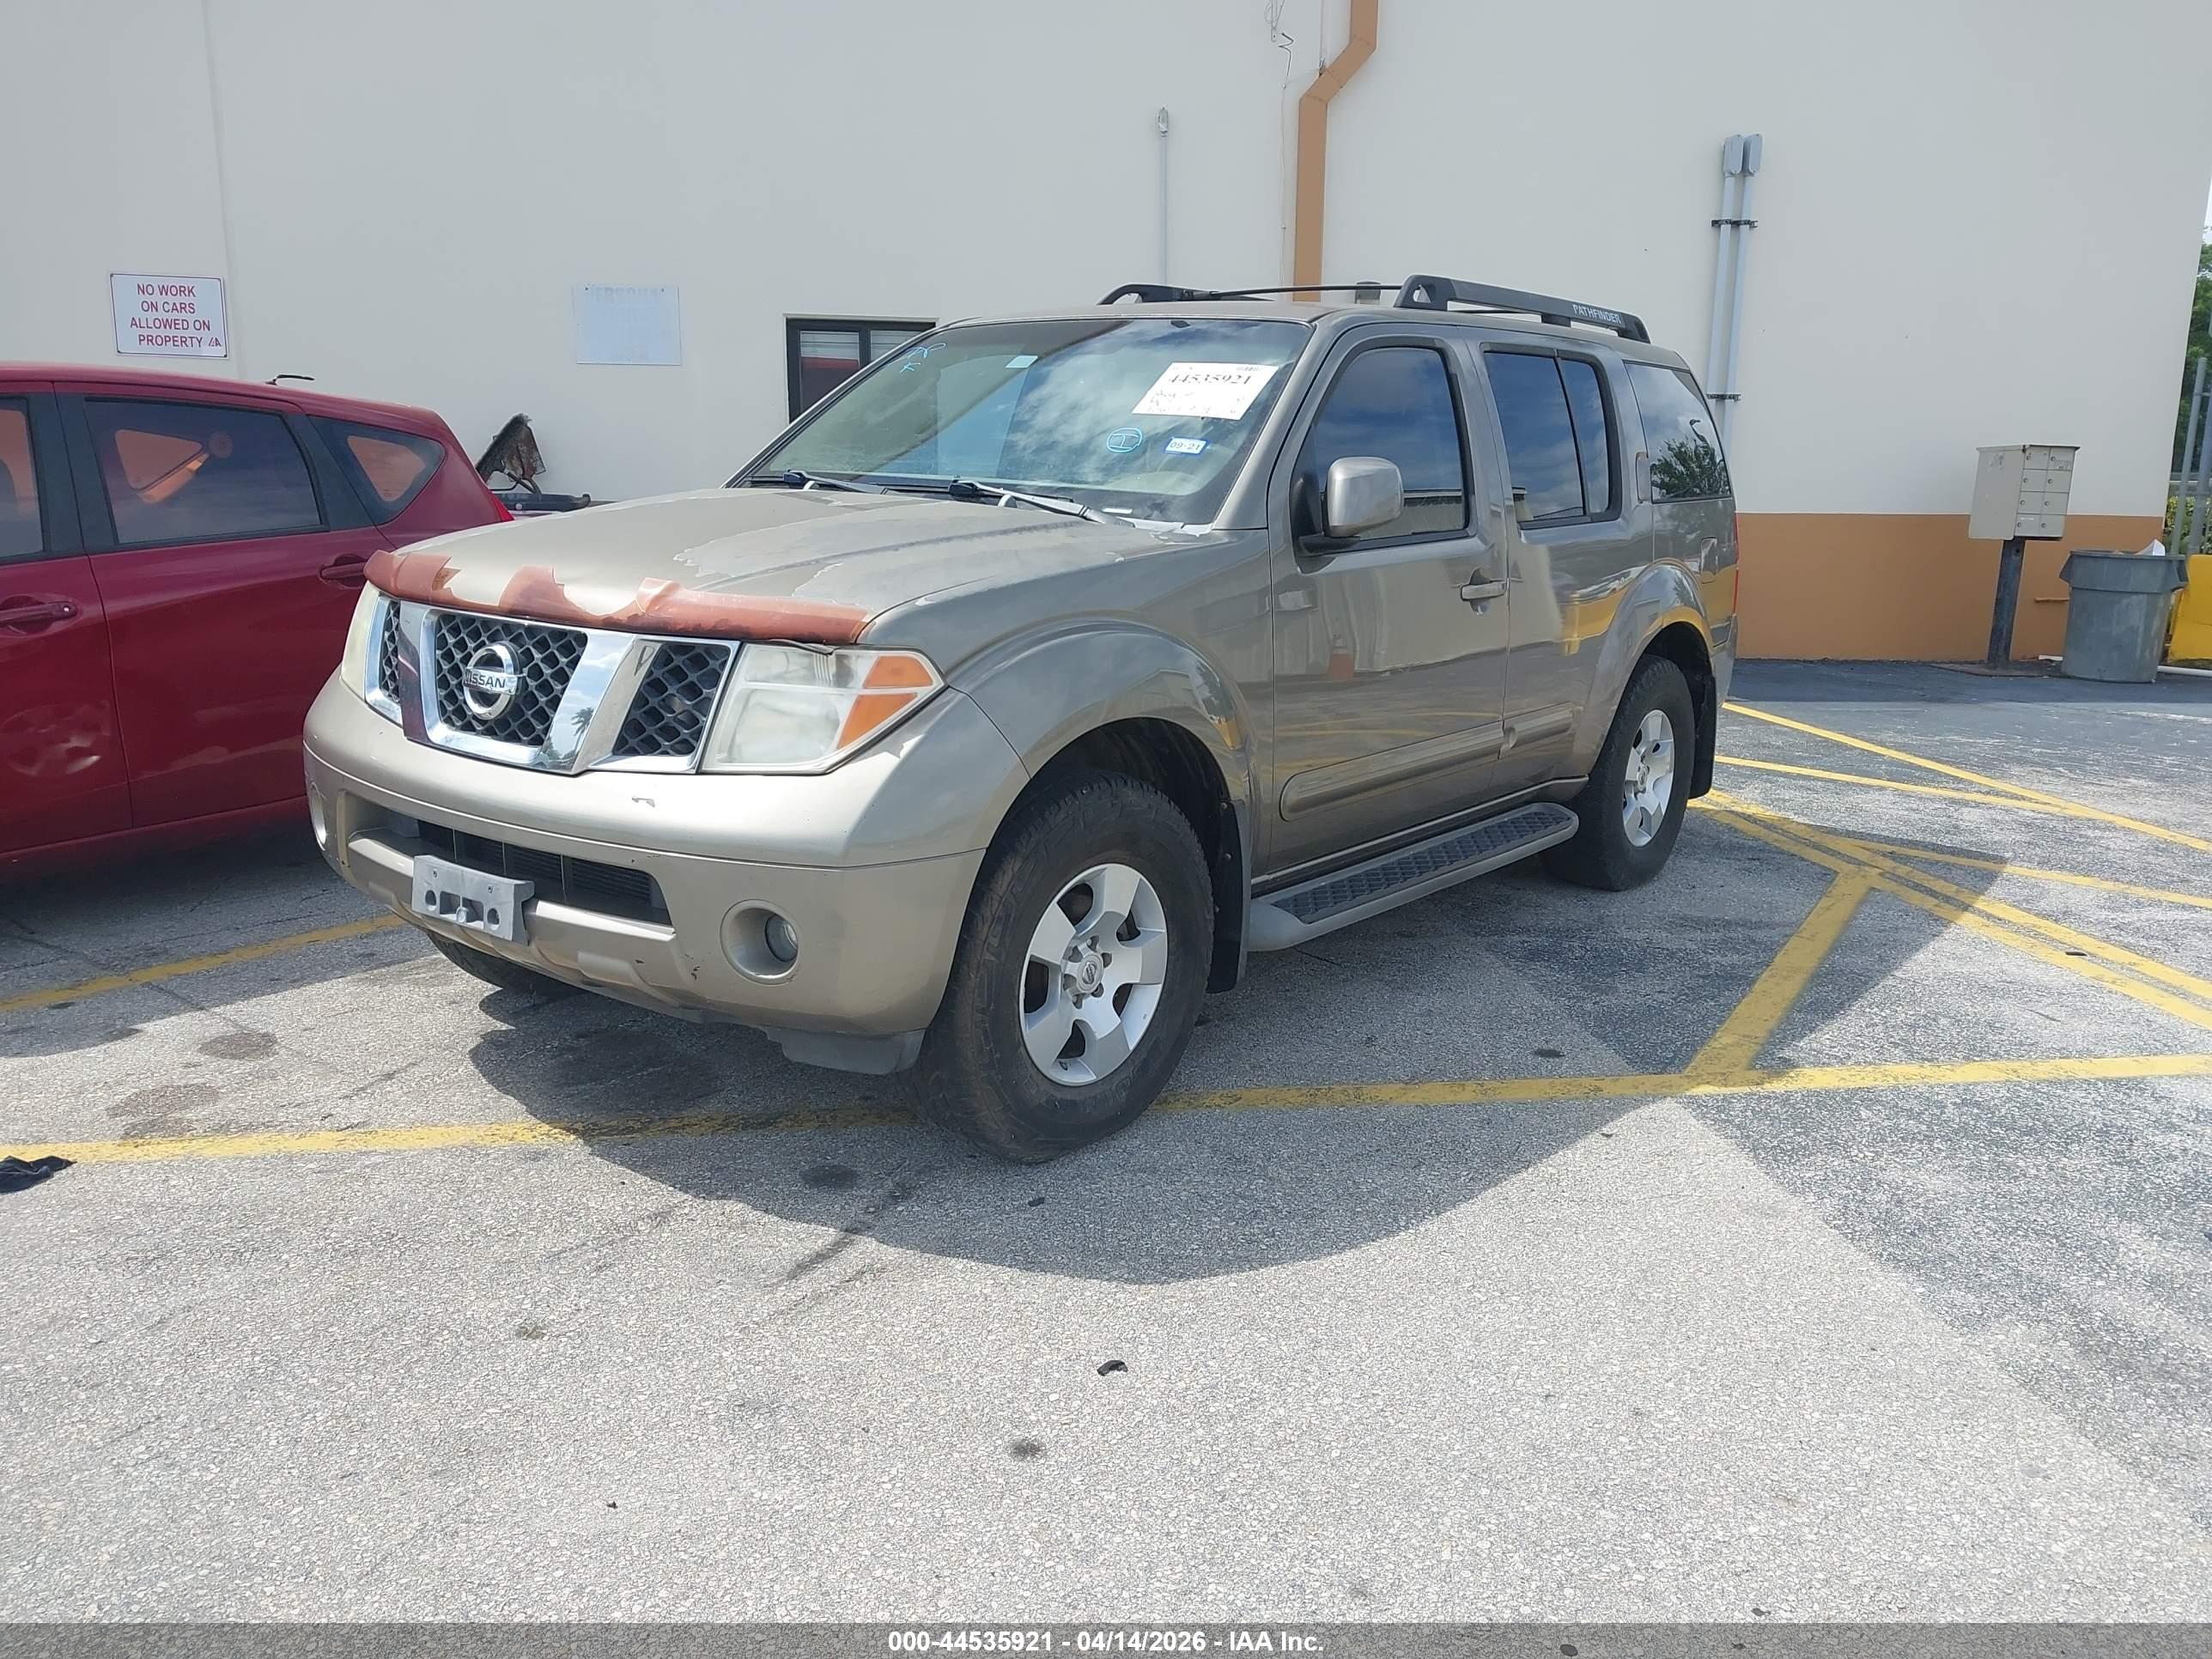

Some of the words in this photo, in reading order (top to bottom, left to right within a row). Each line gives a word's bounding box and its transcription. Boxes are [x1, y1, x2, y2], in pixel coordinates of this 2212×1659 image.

[137, 283, 155, 295] NO
[158, 284, 196, 297] WORK
[141, 301, 158, 313] ON
[162, 301, 196, 314] CARS
[1572, 304, 1622, 324] PATHFINDER
[130, 317, 189, 331] ALLOWED
[193, 319, 210, 331] ON
[138, 334, 203, 348] PROPERTY
[1168, 374, 1252, 385] 44535921
[465, 672, 506, 689] NISSAN
